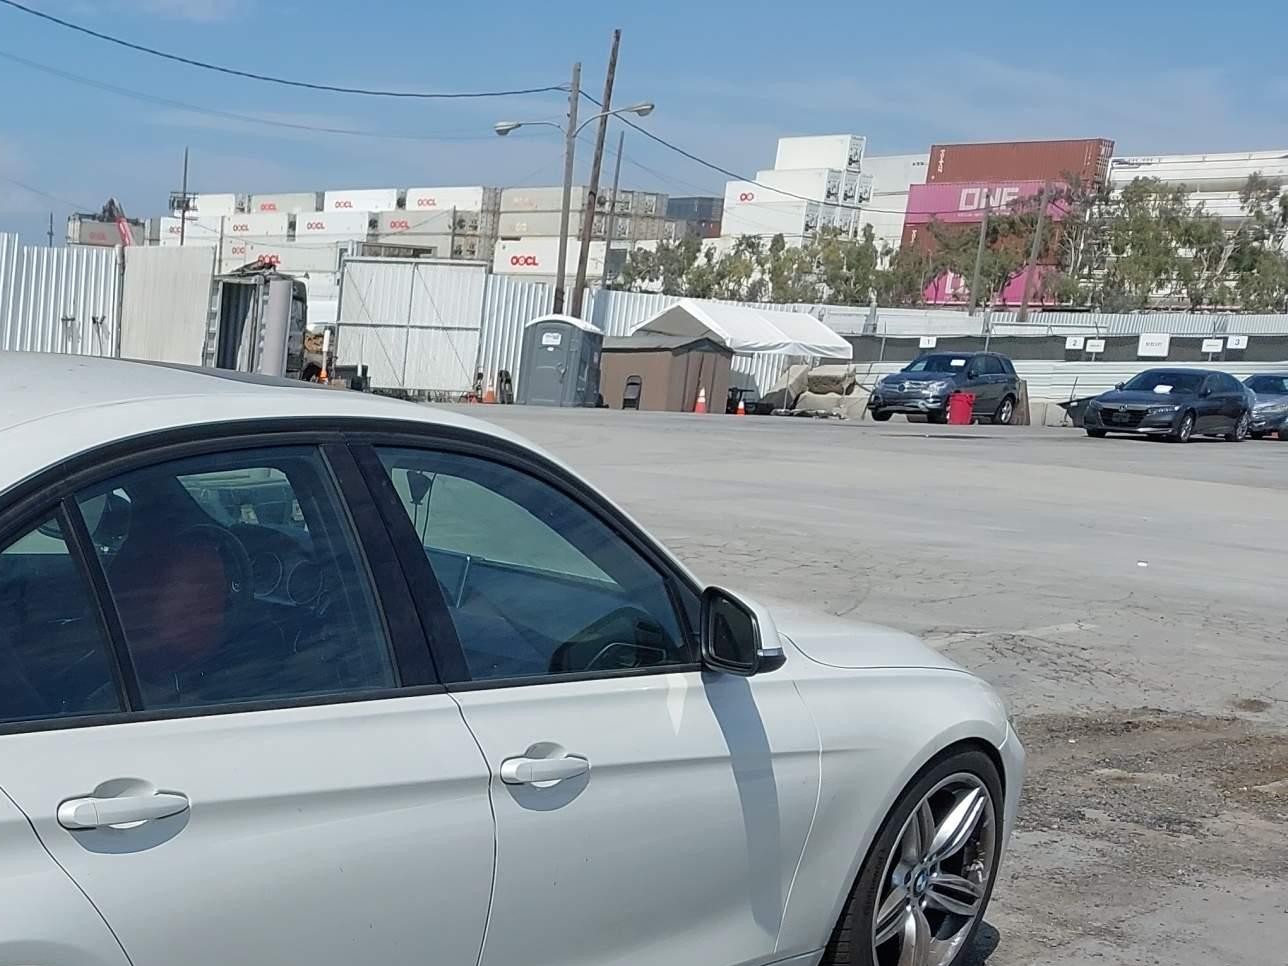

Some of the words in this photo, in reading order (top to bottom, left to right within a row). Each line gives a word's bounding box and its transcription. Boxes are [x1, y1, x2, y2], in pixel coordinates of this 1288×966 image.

[959, 187, 1020, 211] ONE
[334, 201, 354, 209] OOCL
[306, 222, 325, 230] OOCL
[390, 220, 410, 229] OOCL
[510, 255, 538, 267] OOCL
